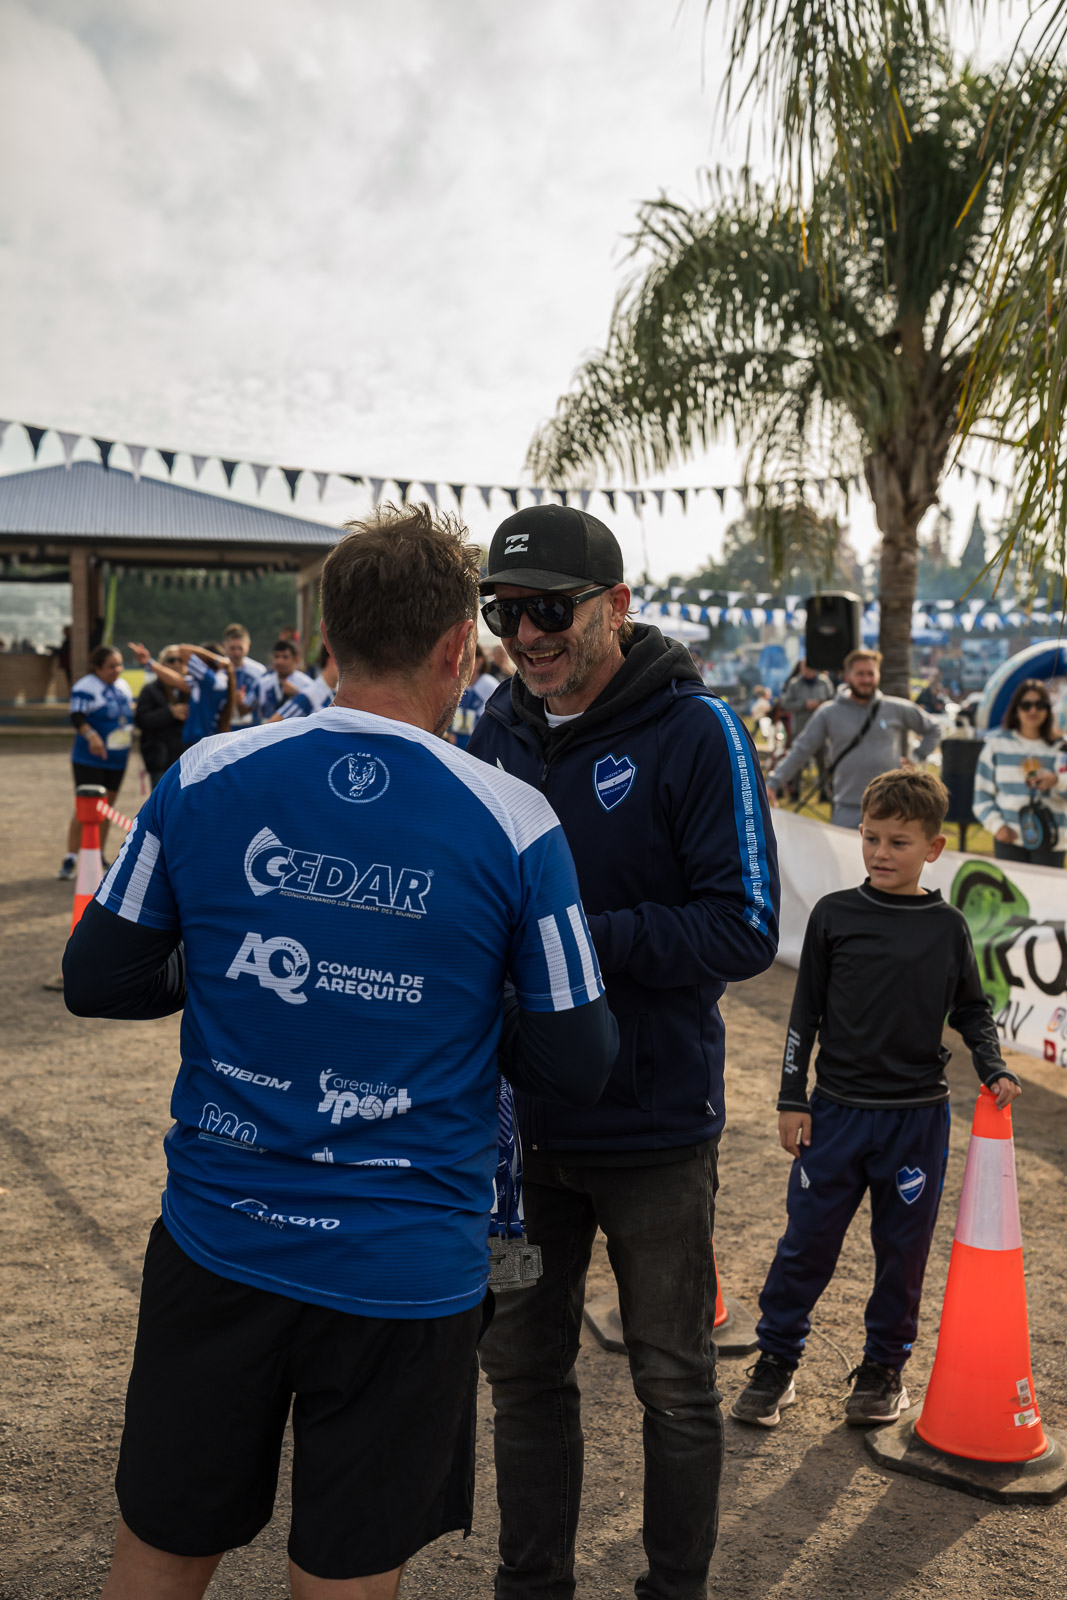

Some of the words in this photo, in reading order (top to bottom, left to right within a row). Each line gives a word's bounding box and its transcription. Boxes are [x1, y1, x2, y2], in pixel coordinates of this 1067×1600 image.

[729, 726, 743, 751] BELGRANO
[603, 768, 623, 780] ORDEN
[736, 755, 747, 768] CLUB
[741, 790, 754, 815] BELGRANO
[745, 819, 755, 832] CLUB
[250, 844, 431, 914] CEDAR
[748, 855, 761, 879] BELGRANO
[752, 882, 763, 896] CLUB
[279, 890, 336, 905] ACONDICIONANDO
[351, 903, 379, 912] GRANOS
[395, 910, 422, 920] MUNDO
[317, 960, 395, 985] COMUNA
[399, 974, 425, 989] DE
[314, 975, 422, 1004] AREQUITO
[333, 1077, 397, 1096] arequito
[317, 1088, 412, 1126] sport
